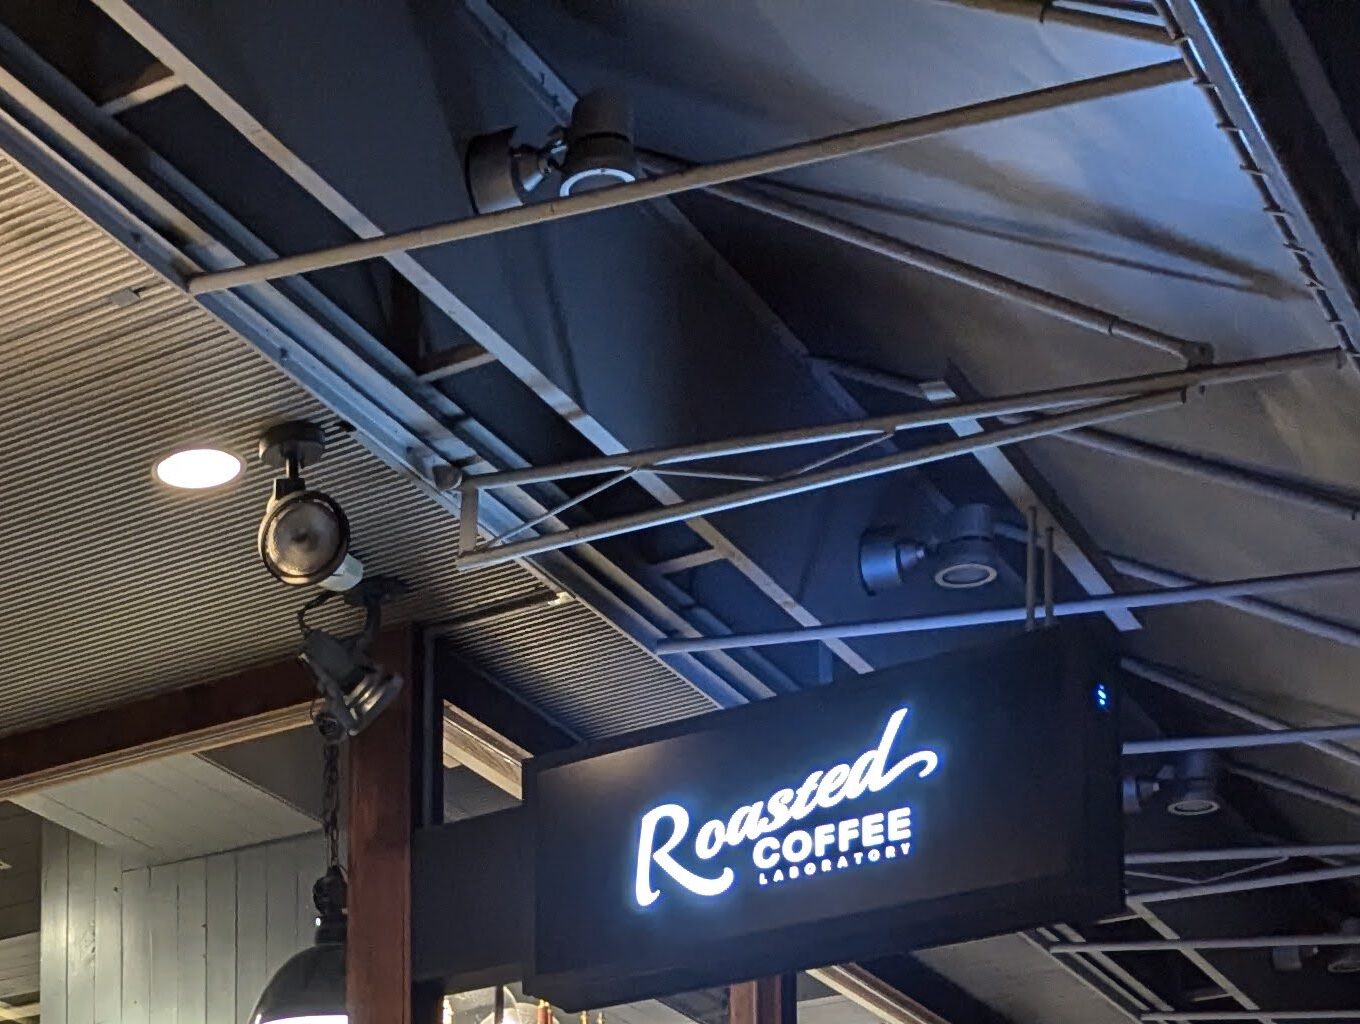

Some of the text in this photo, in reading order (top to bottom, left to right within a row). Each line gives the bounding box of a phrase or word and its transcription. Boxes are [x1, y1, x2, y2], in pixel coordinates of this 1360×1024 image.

[636, 707, 938, 907] Roasted
[752, 806, 912, 869] COFFEE
[758, 842, 912, 886] LABORATORY
